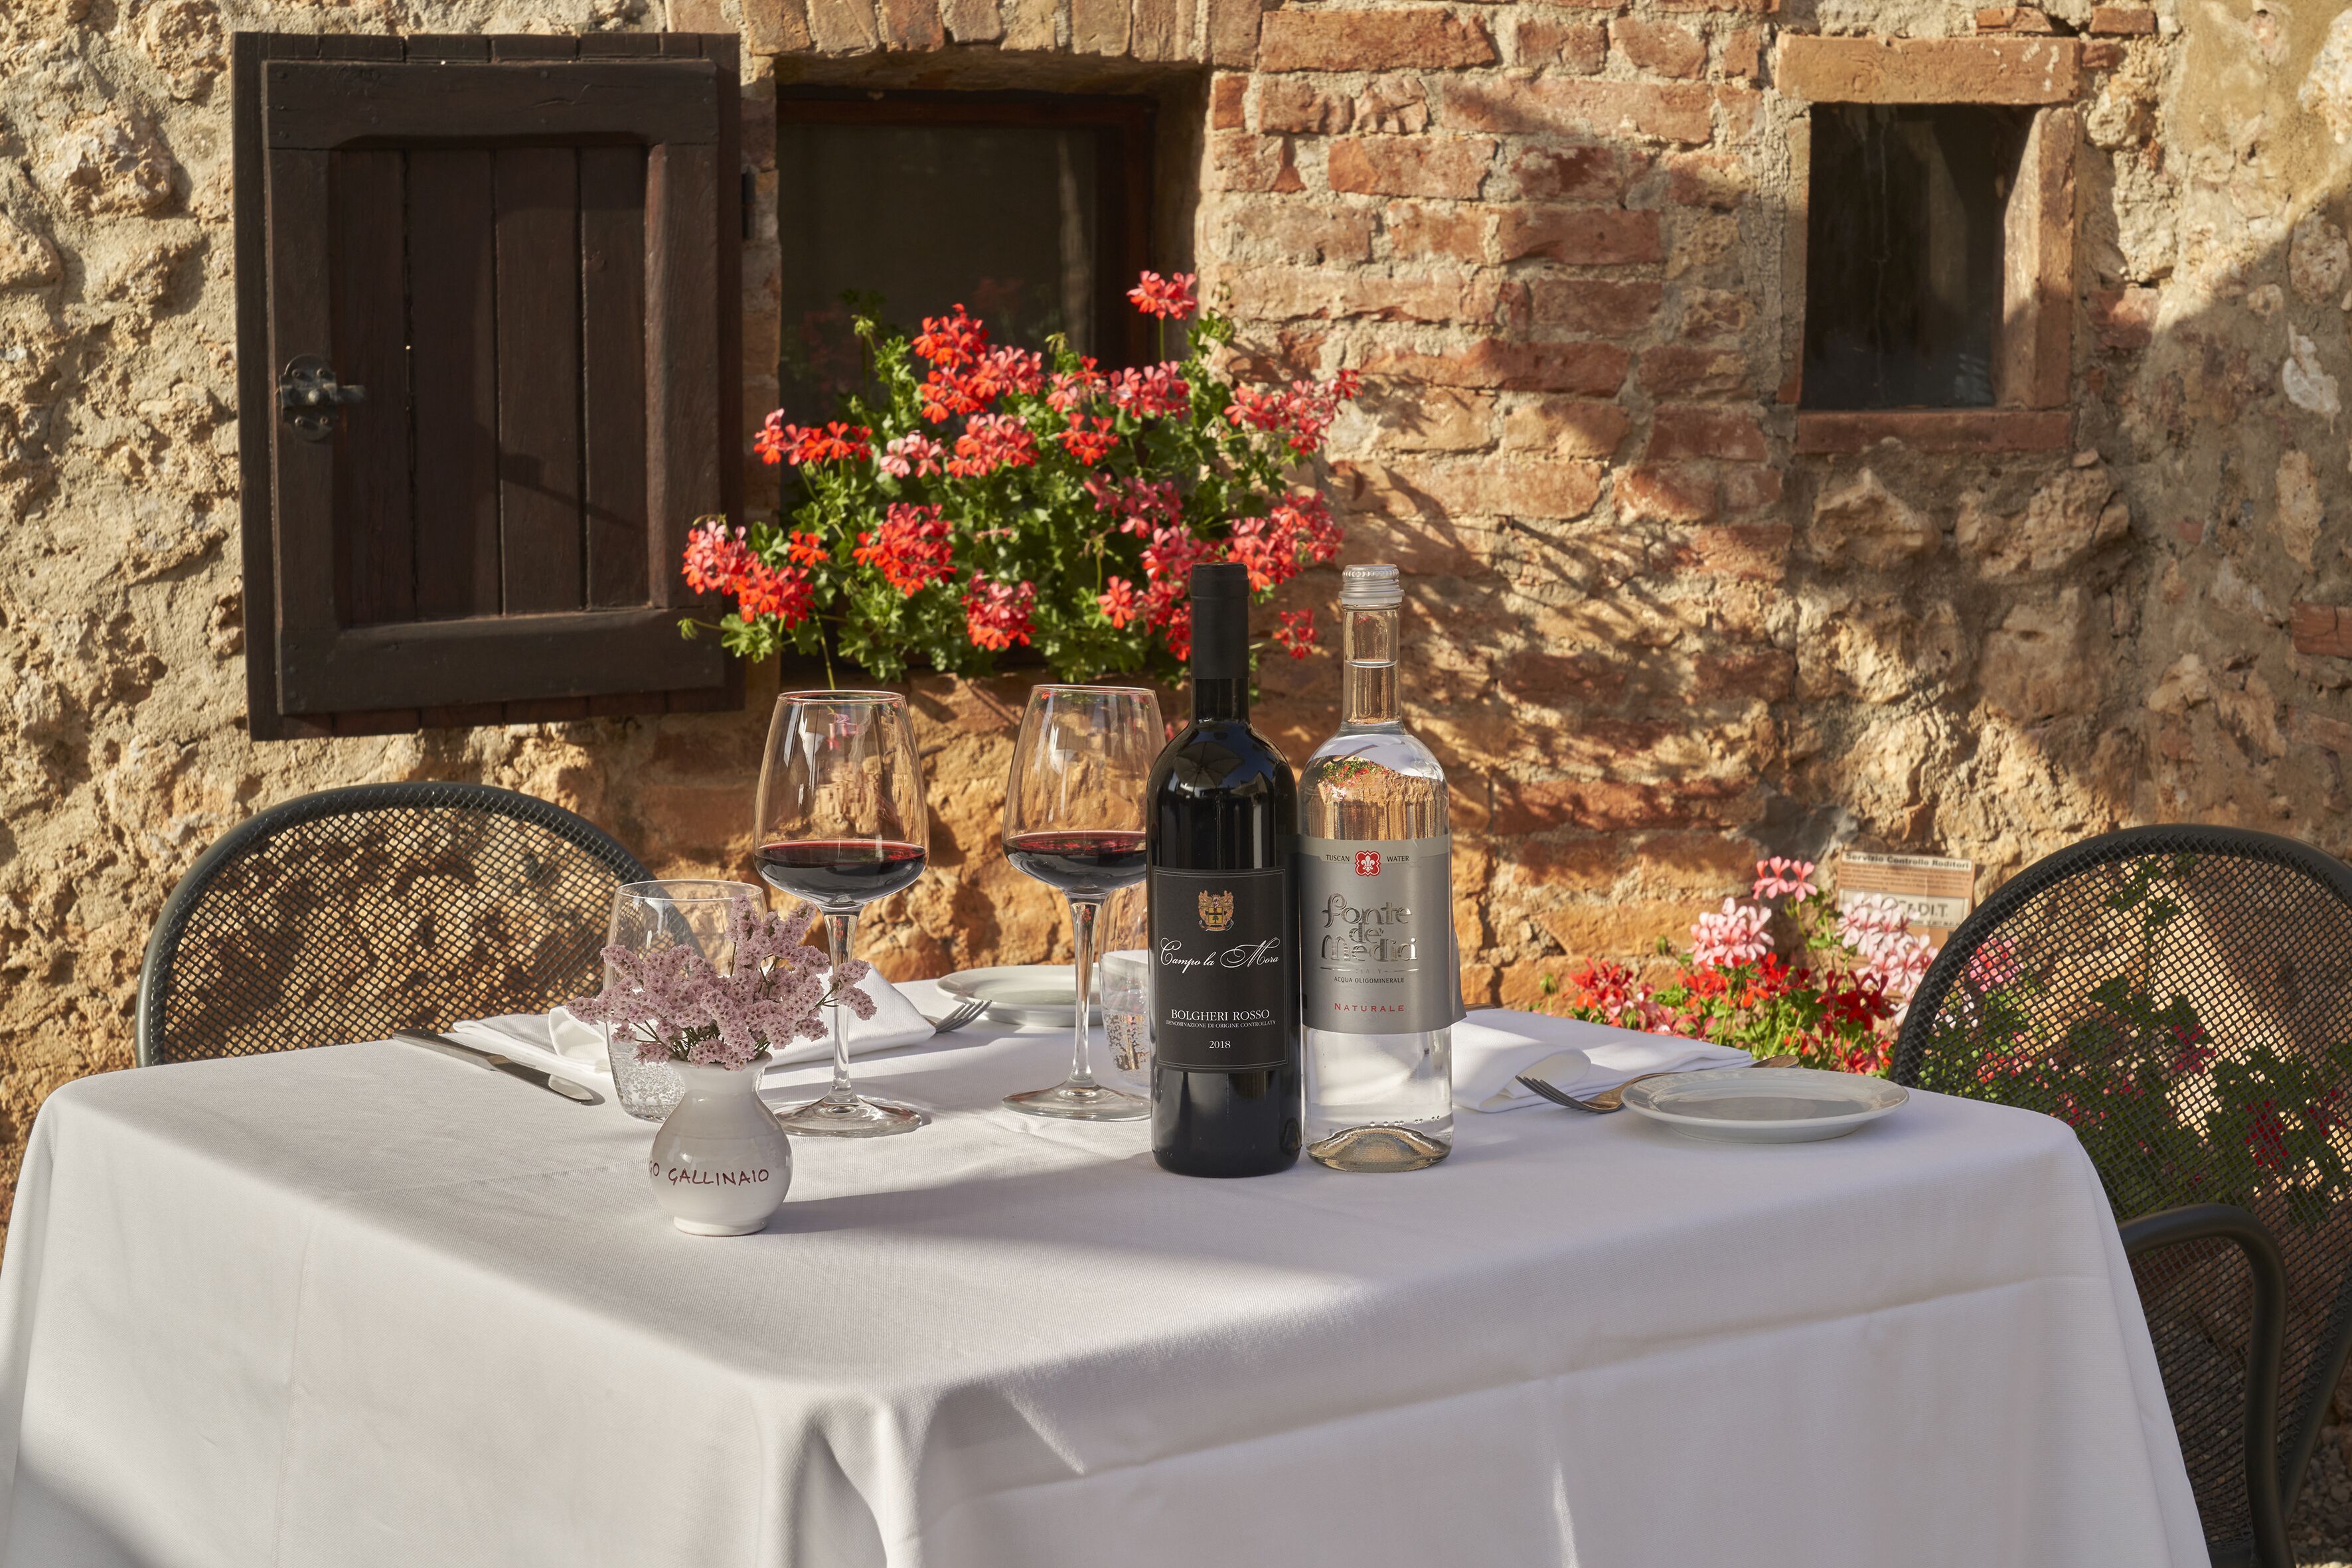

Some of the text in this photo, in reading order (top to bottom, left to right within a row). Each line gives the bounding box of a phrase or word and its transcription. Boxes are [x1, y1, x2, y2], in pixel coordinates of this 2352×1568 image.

[1845, 852, 1969, 869] Servizio Controllo Roditori
[1160, 937, 1201, 974] Campo
[1219, 937, 1281, 968] Mora
[1334, 1003, 1405, 1012] NATURALE
[1171, 1009, 1270, 1021] BOLGHERI ROSSO
[1166, 1020, 1207, 1028] DENOMINAZIONE
[1209, 1040, 1231, 1049] 2018
[668, 1168, 769, 1186] GALLINAIO
